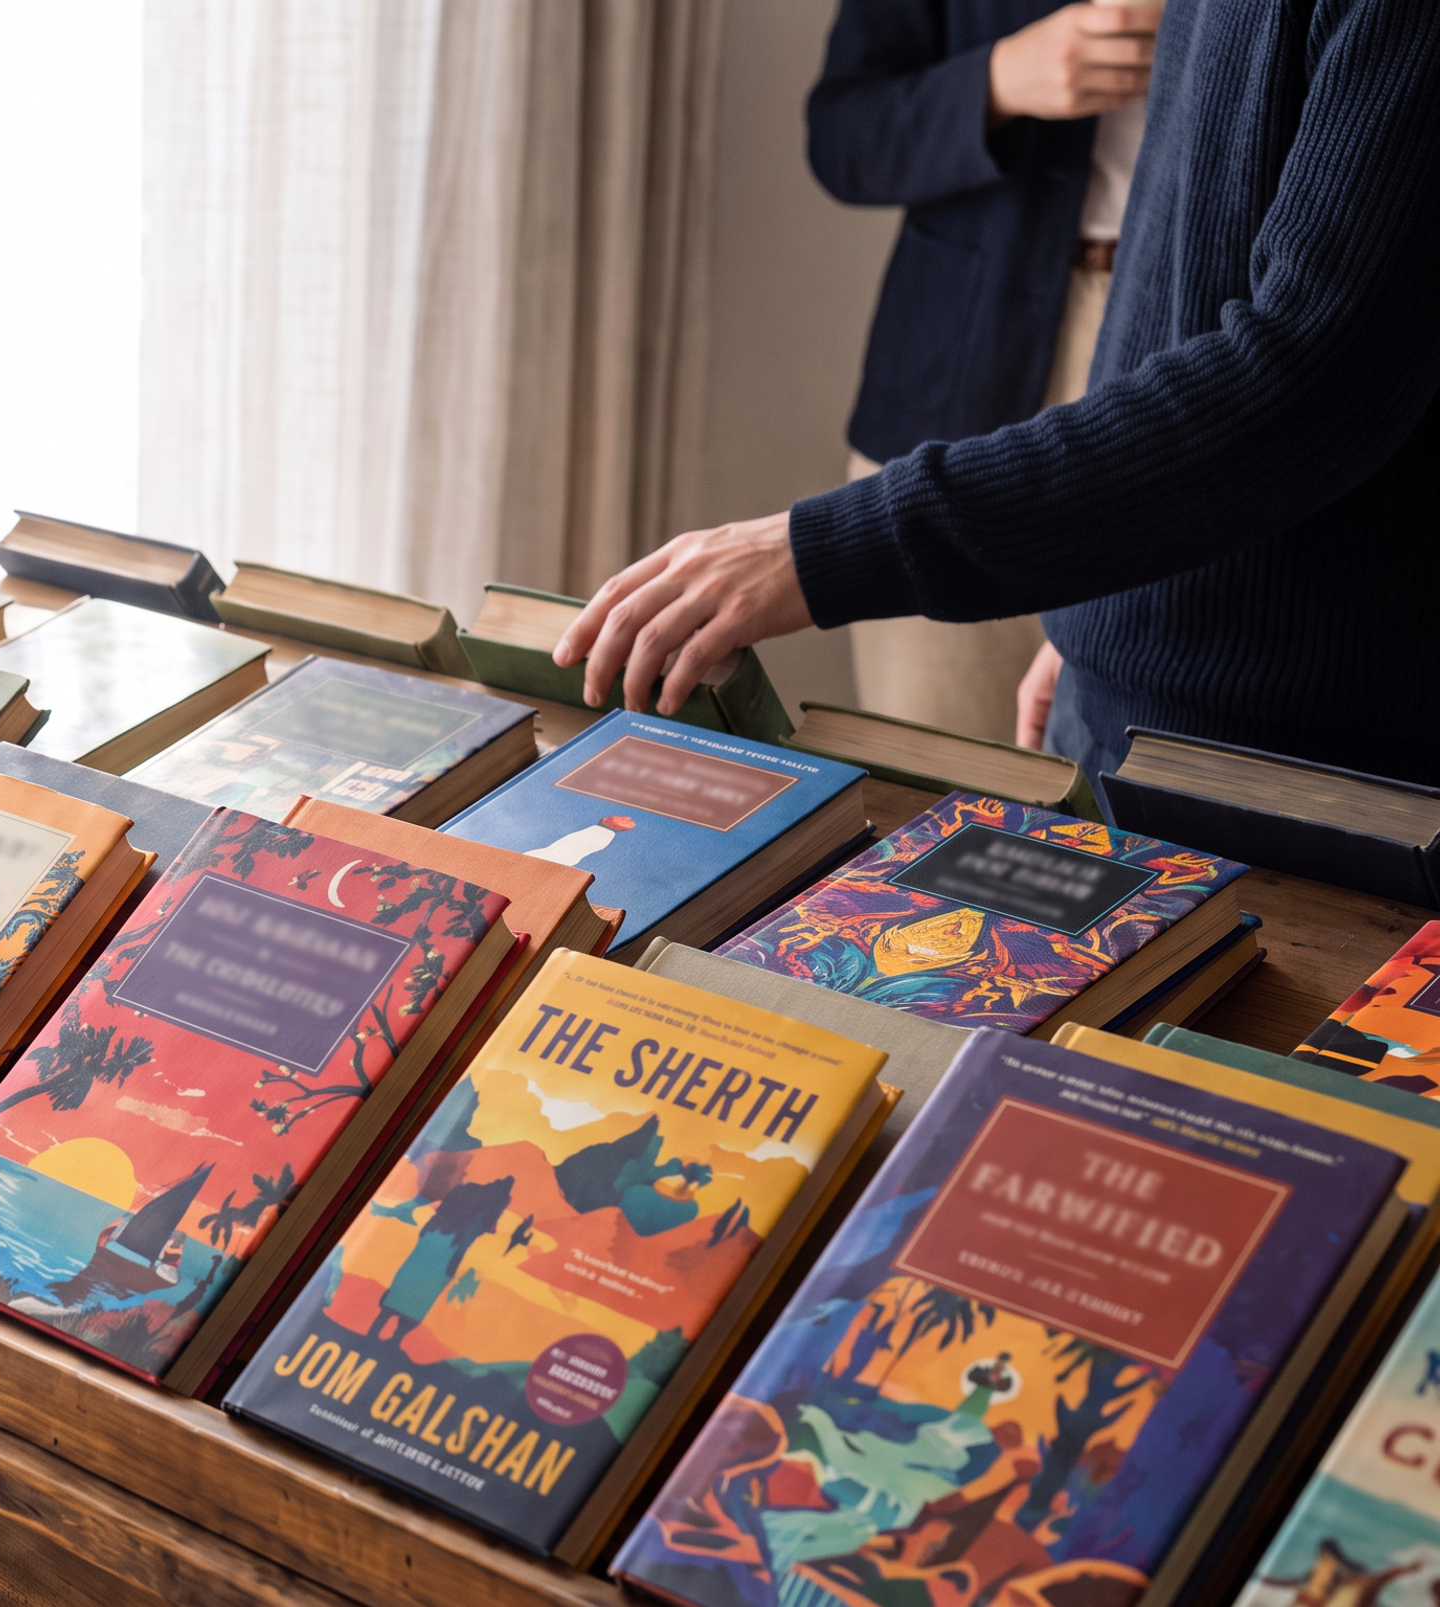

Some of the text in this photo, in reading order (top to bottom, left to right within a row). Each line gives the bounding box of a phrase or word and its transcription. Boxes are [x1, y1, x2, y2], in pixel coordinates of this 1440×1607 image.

[518, 1003, 621, 1075] THE
[614, 1038, 820, 1144] SHERTH
[1081, 1151, 1163, 1199] THE
[274, 1333, 378, 1405] JOM
[370, 1372, 577, 1497] GALSHAN
